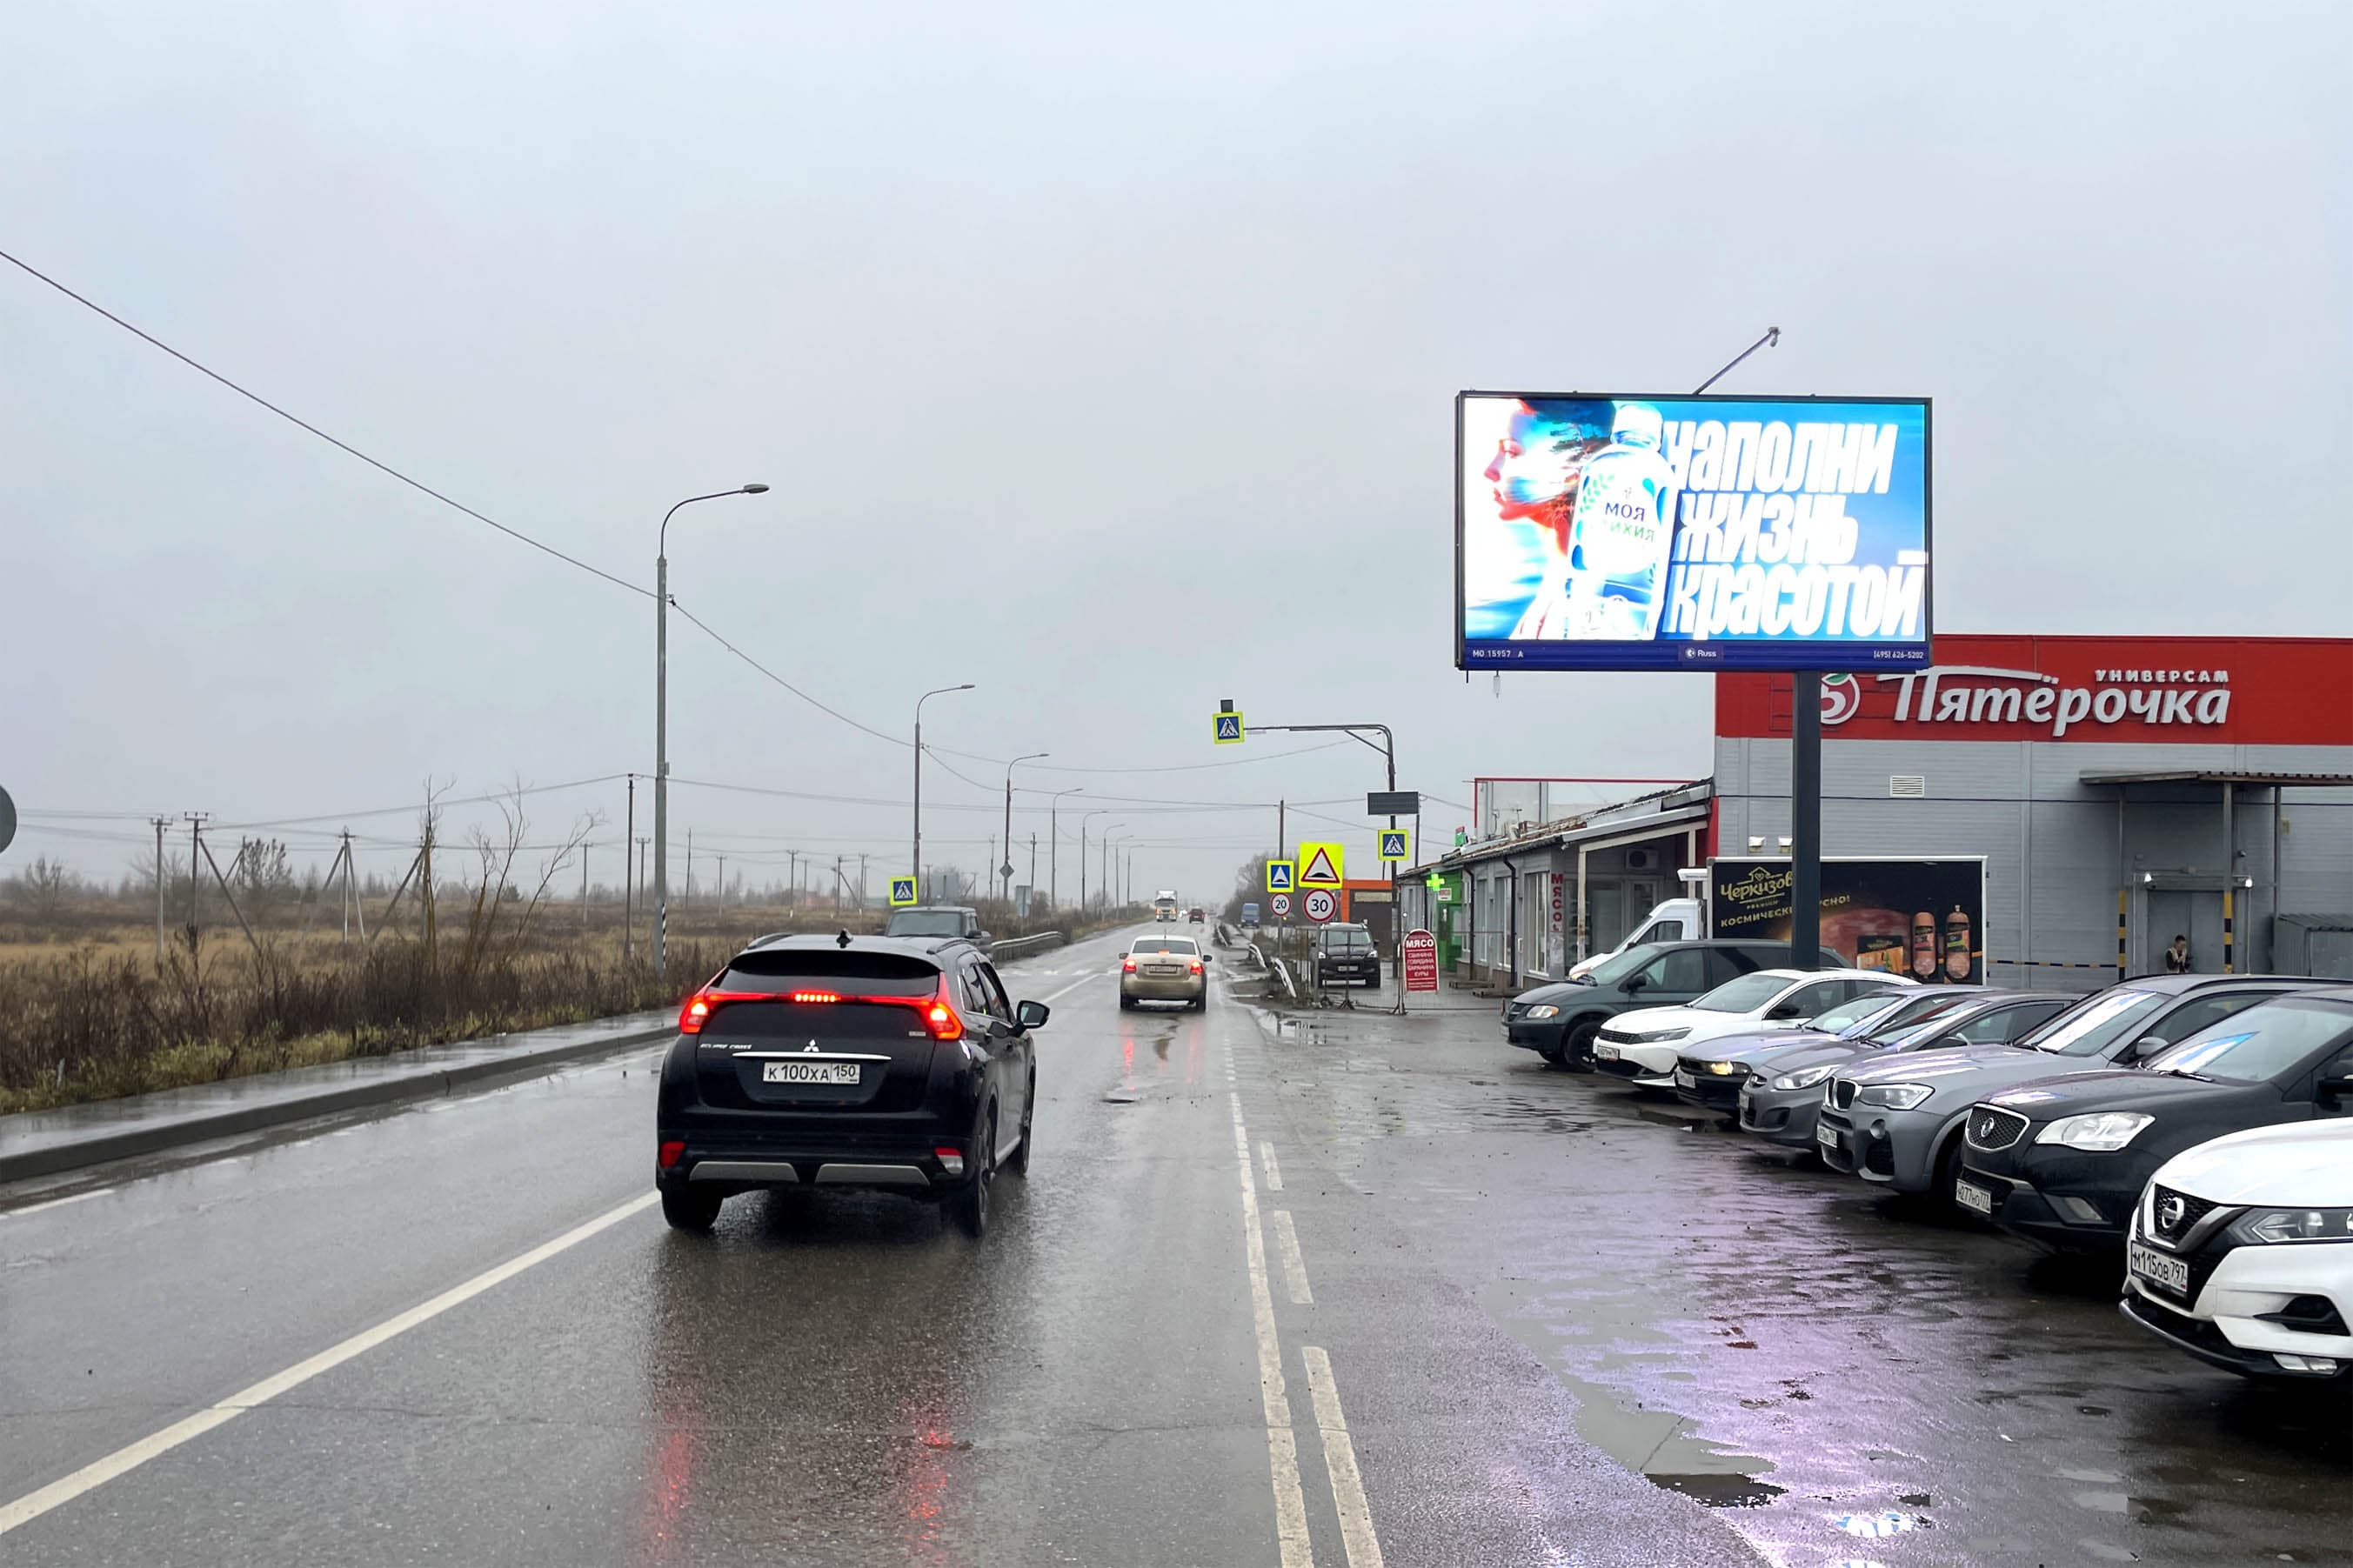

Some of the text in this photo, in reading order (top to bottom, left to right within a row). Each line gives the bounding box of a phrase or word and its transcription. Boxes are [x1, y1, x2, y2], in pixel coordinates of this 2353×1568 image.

[1605, 502, 1645, 522] МОЯ
[1602, 521, 1654, 543] ИХИЯ
[1697, 649, 1717, 657] Russ
[2095, 669, 2229, 684] УНИВЕРСАМ
[1721, 871, 1793, 901] Черкизов
[1275, 899, 1287, 910] 20
[1311, 898, 1329, 912] 30
[1551, 873, 1564, 922] МЯСО
[1721, 895, 1851, 928] КОСМИЧЕСК СНО!
[1406, 939, 1434, 948] МЯСО
